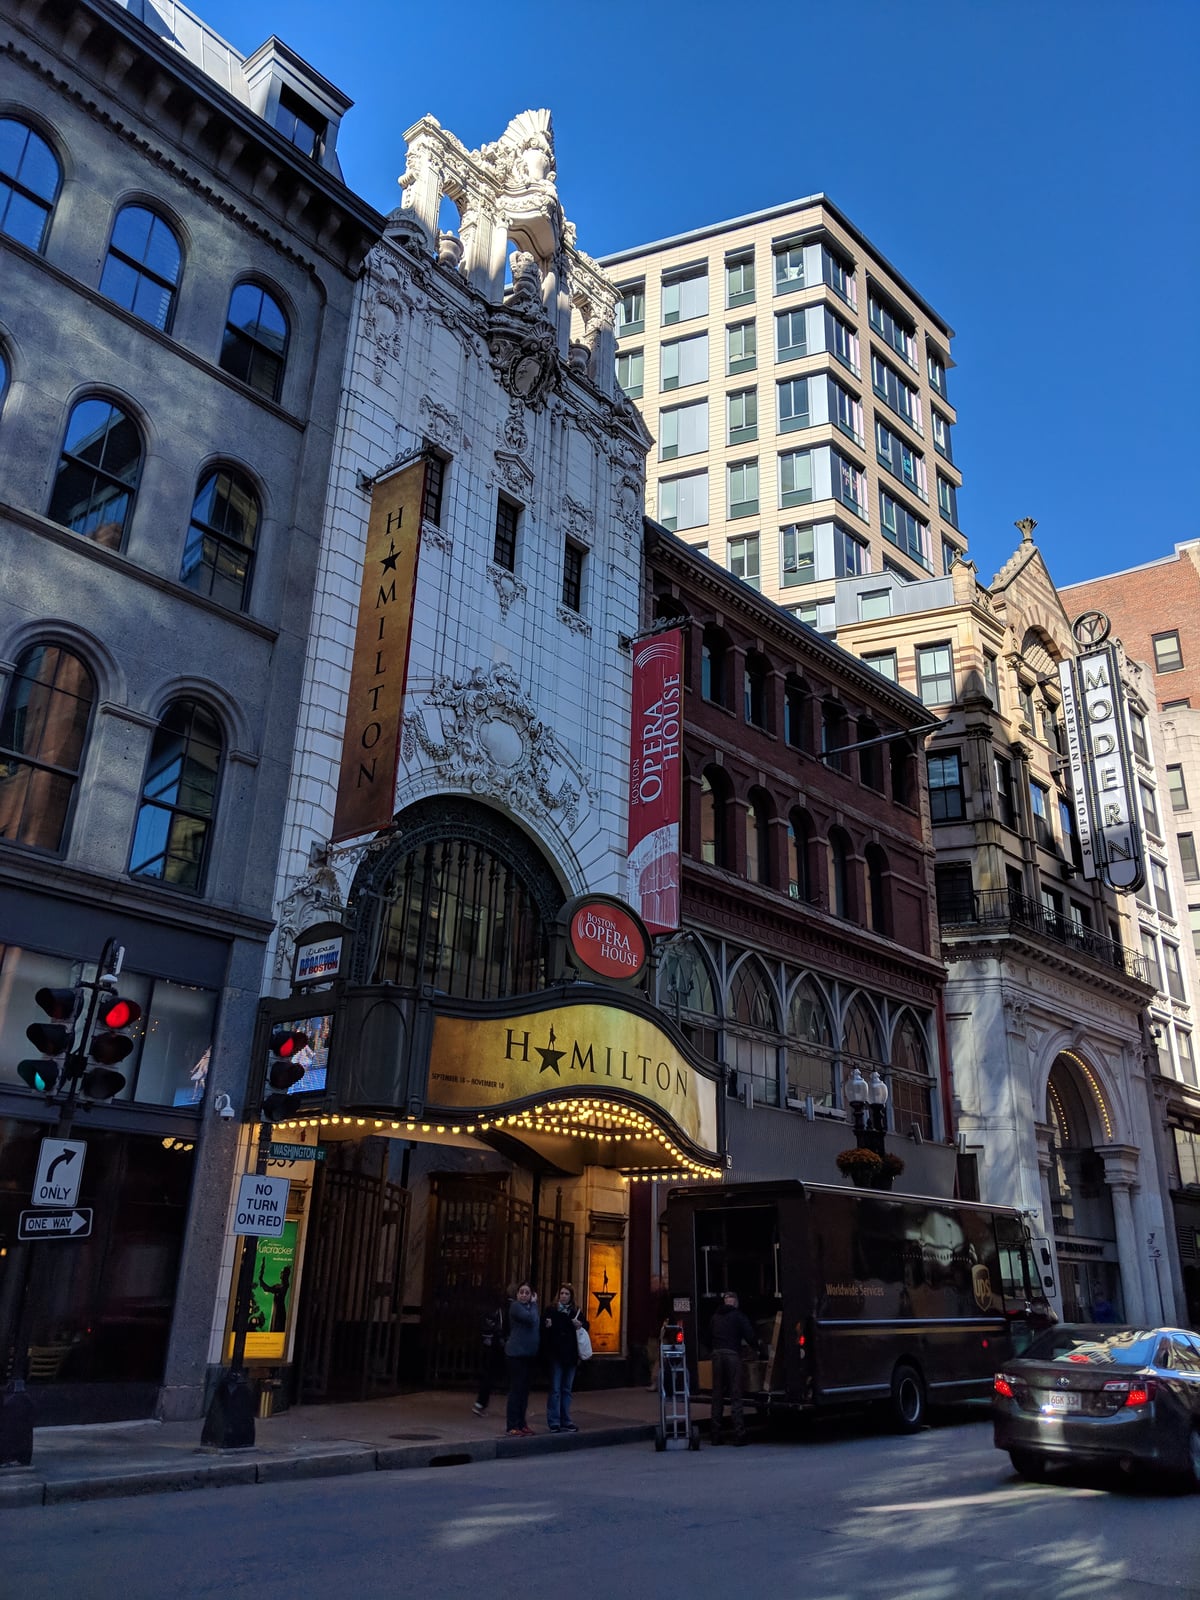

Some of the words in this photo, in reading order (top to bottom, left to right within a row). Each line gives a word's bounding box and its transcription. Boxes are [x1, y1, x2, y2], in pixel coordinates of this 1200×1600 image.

[662, 673, 680, 762] HOUSE
[1063, 684, 1081, 772] UNIVERSITY
[639, 699, 663, 803] OPERA
[1085, 665, 1131, 862] MODERN
[631, 758, 640, 805] BOSTON
[1076, 786, 1092, 856] SUFFOLK
[587, 912, 617, 930] BOSTON
[585, 922, 630, 950] OPERA
[601, 944, 639, 968] HOUSE
[308, 960, 339, 975] BOSTON
[471, 1078, 497, 1088] NOVEMBER
[273, 1144, 316, 1160] WASHINGTON
[317, 1151, 324, 1160] ST
[40, 1186, 72, 1200] ONLY
[255, 1183, 272, 1196] NO
[246, 1198, 279, 1212] TURN
[28, 1218, 47, 1229] ONE
[52, 1217, 72, 1228] WAY
[237, 1212, 255, 1225] ON
[257, 1214, 281, 1227] RED
[826, 1283, 858, 1296] Worldwide
[859, 1284, 885, 1297] Services
[975, 1279, 991, 1304] ups
